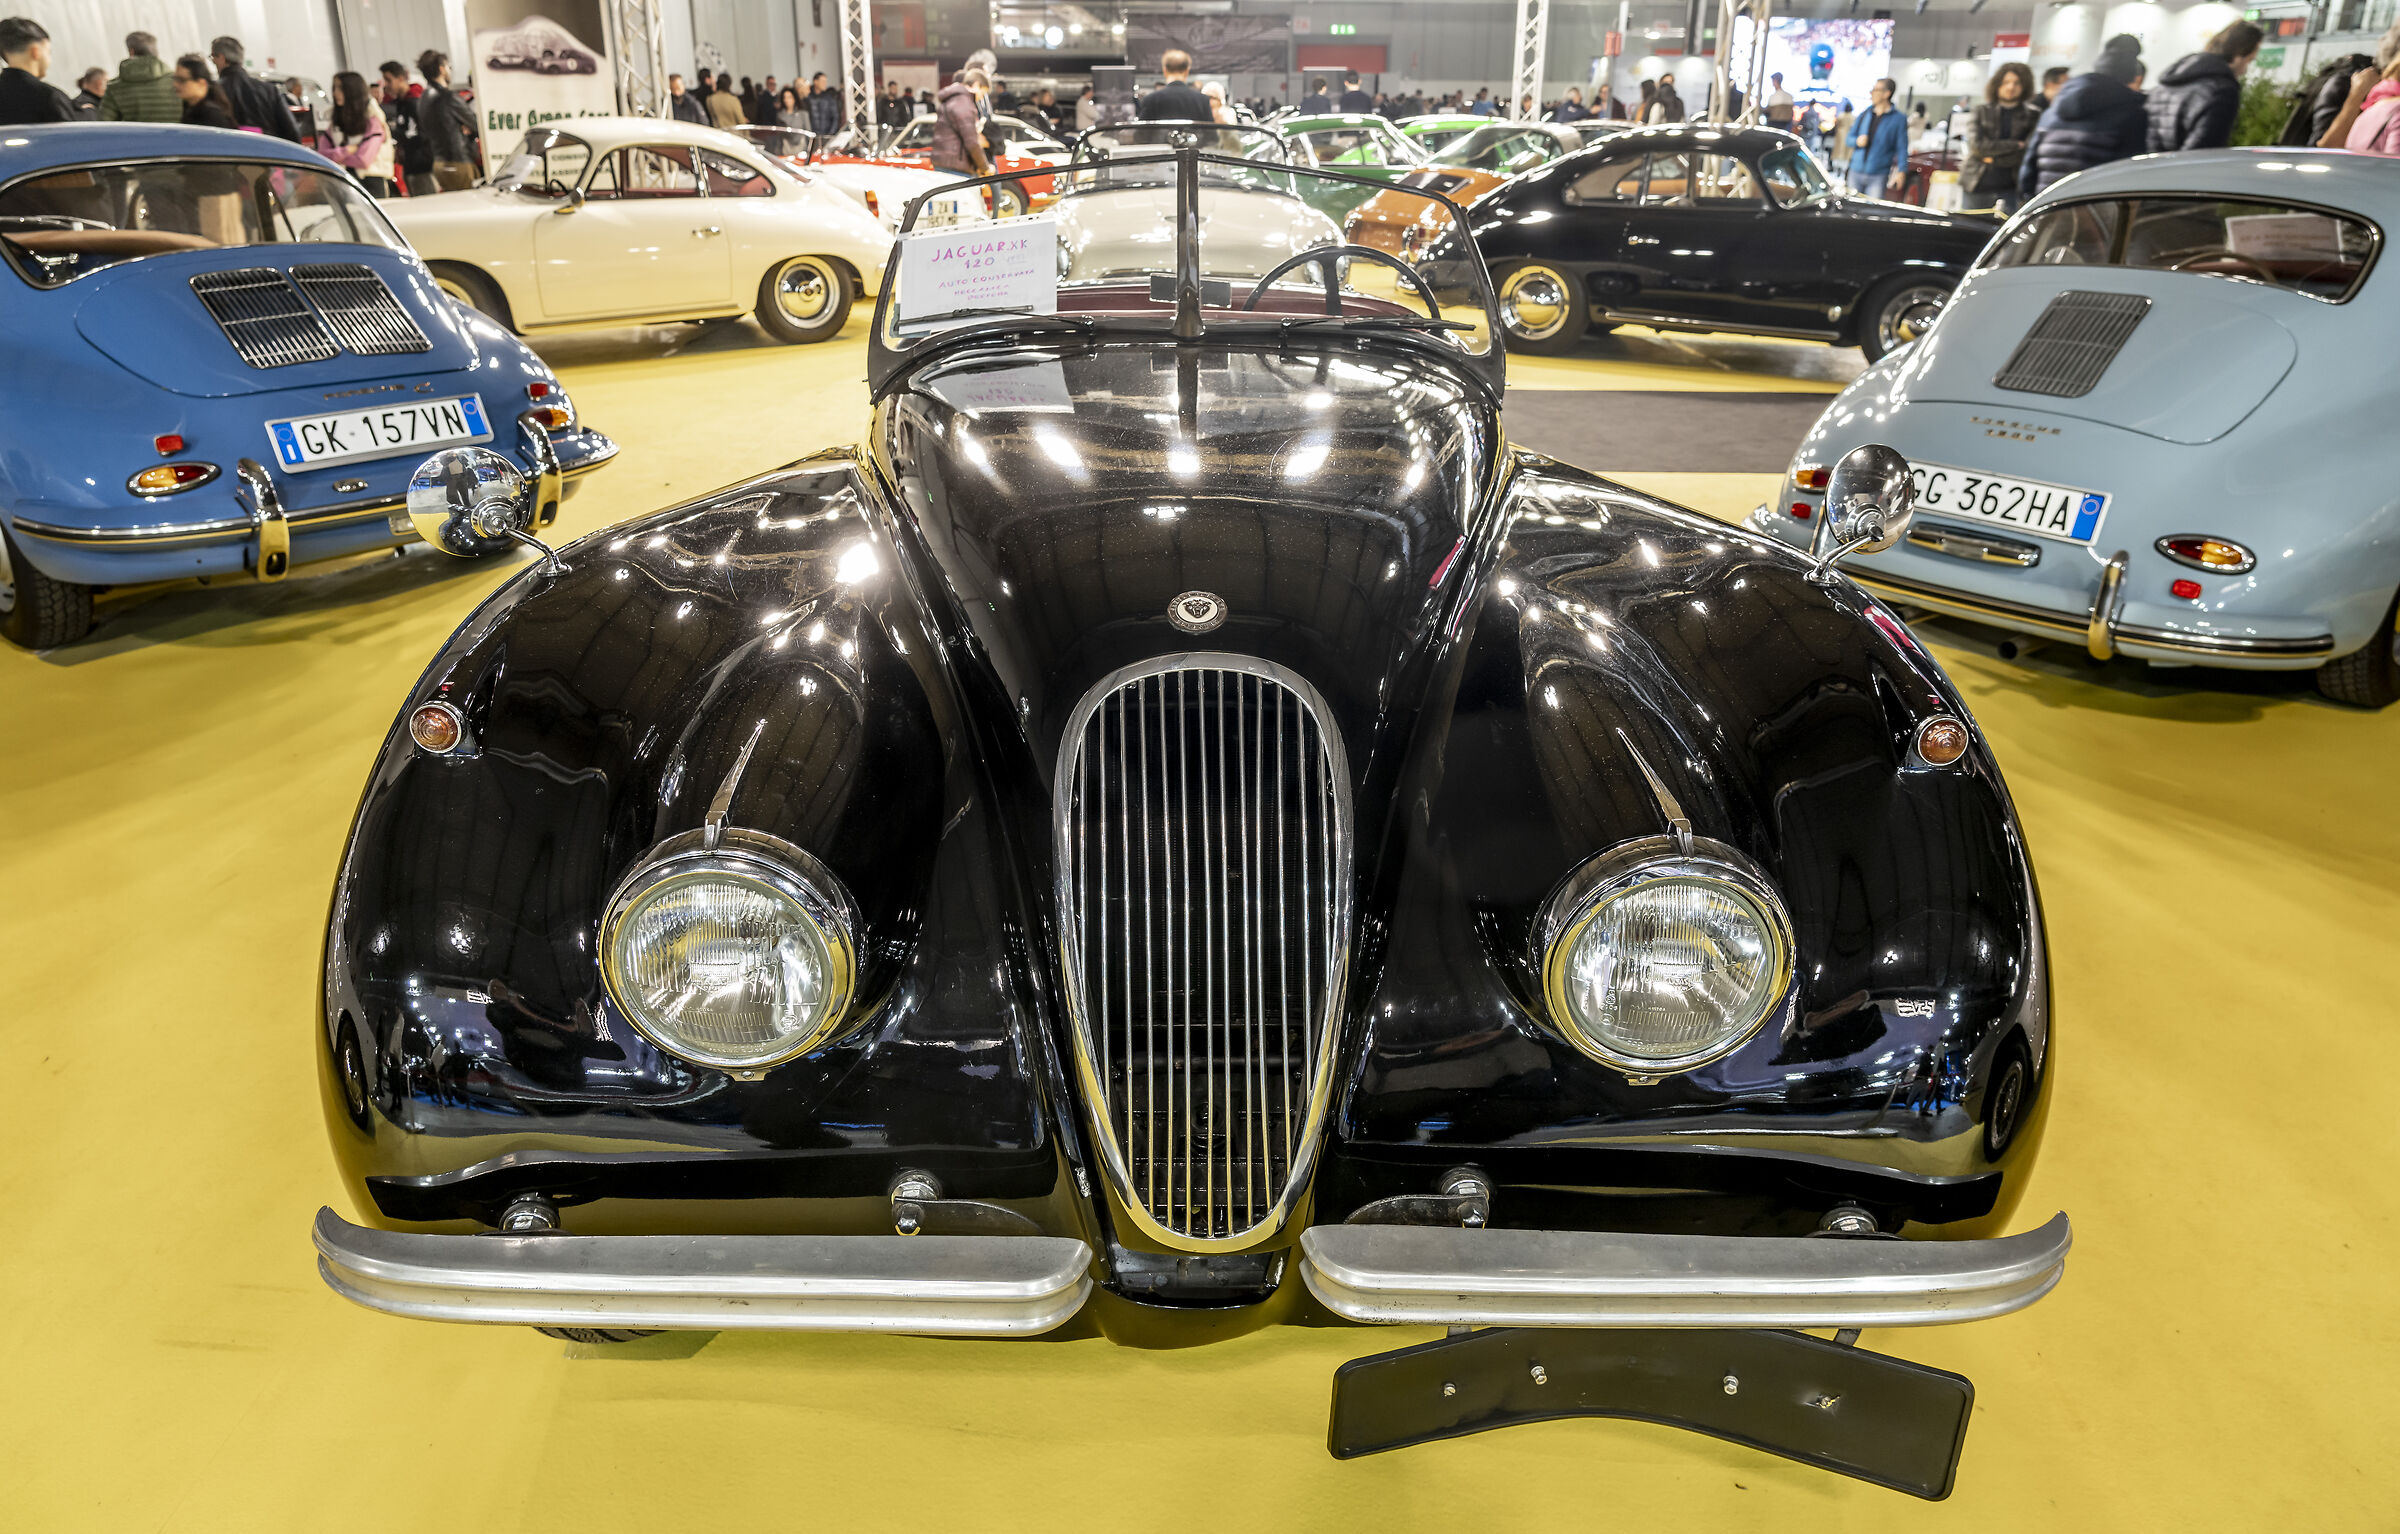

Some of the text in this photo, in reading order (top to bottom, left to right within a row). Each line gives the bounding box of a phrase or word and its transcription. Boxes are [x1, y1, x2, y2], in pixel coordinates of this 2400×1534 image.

[488, 109, 521, 130] Ever
[931, 240, 1006, 263] JAGUAR
[964, 256, 995, 269] 120
[938, 279, 969, 289] AUTO
[300, 403, 466, 455] GK 157VN
[1957, 476, 2071, 531] 362HA
